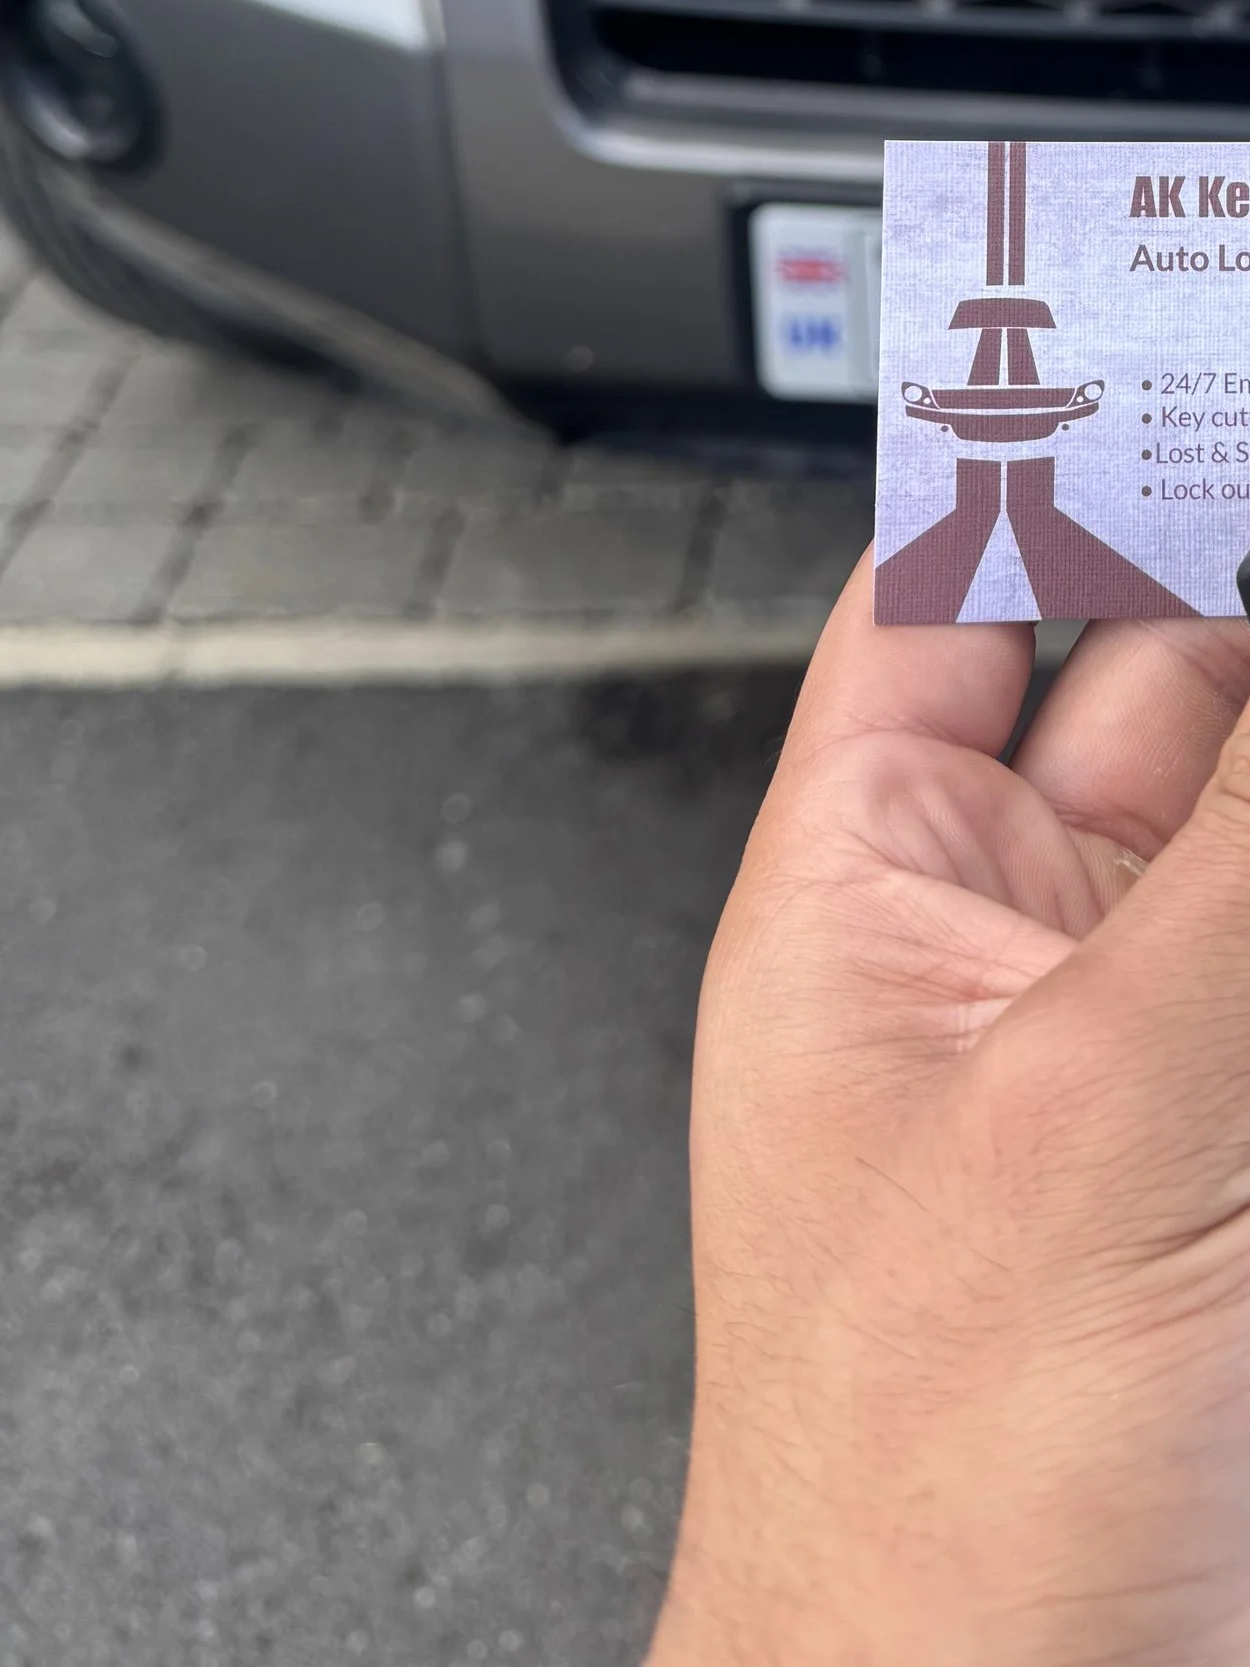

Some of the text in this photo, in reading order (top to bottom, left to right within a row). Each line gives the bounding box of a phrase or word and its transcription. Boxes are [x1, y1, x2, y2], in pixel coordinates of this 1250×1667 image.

[1128, 175, 1186, 219] AK
[1129, 243, 1210, 272] Auto
[1160, 373, 1217, 397] 24/7
[1160, 406, 1208, 433] Key
[1156, 440, 1206, 464] Lost
[1210, 441, 1230, 464] &
[1160, 477, 1215, 500] Lock
